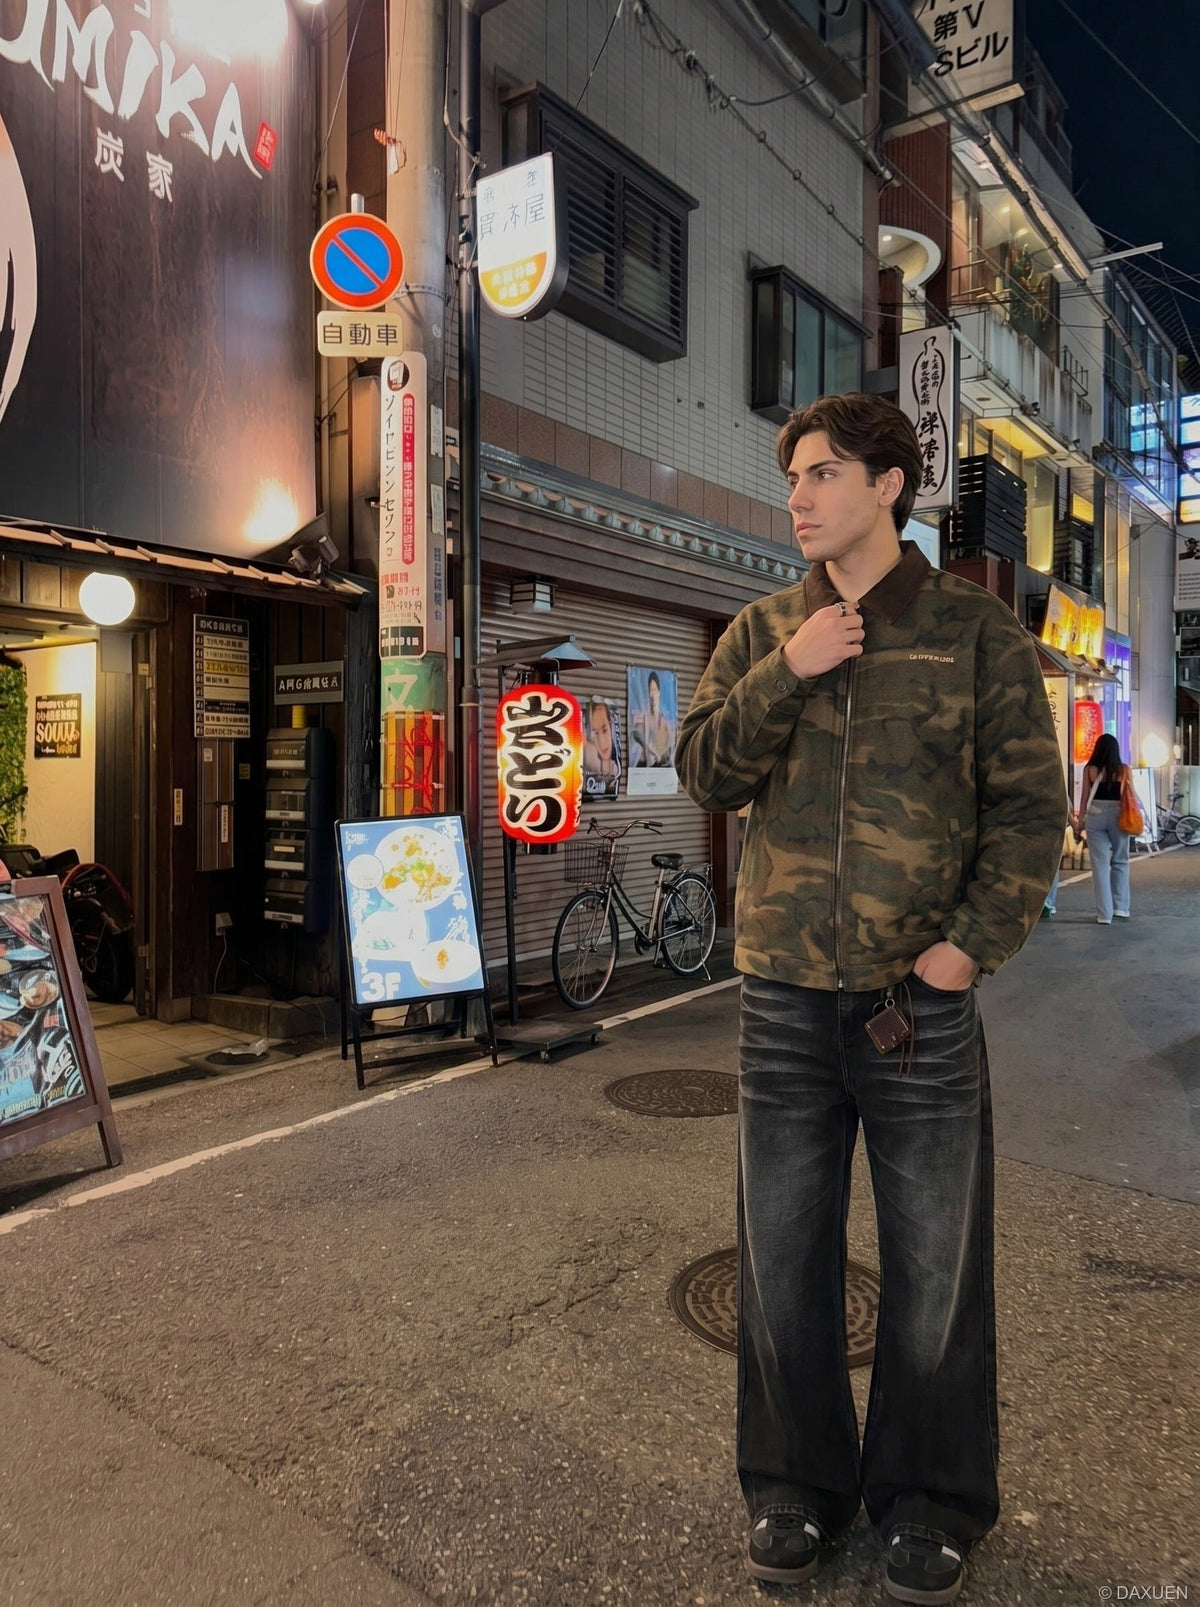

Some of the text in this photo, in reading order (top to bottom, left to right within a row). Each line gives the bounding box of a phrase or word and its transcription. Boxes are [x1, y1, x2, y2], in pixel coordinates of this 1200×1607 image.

[322, 322, 399, 347] 自動車
[361, 971, 401, 1002] 3F
